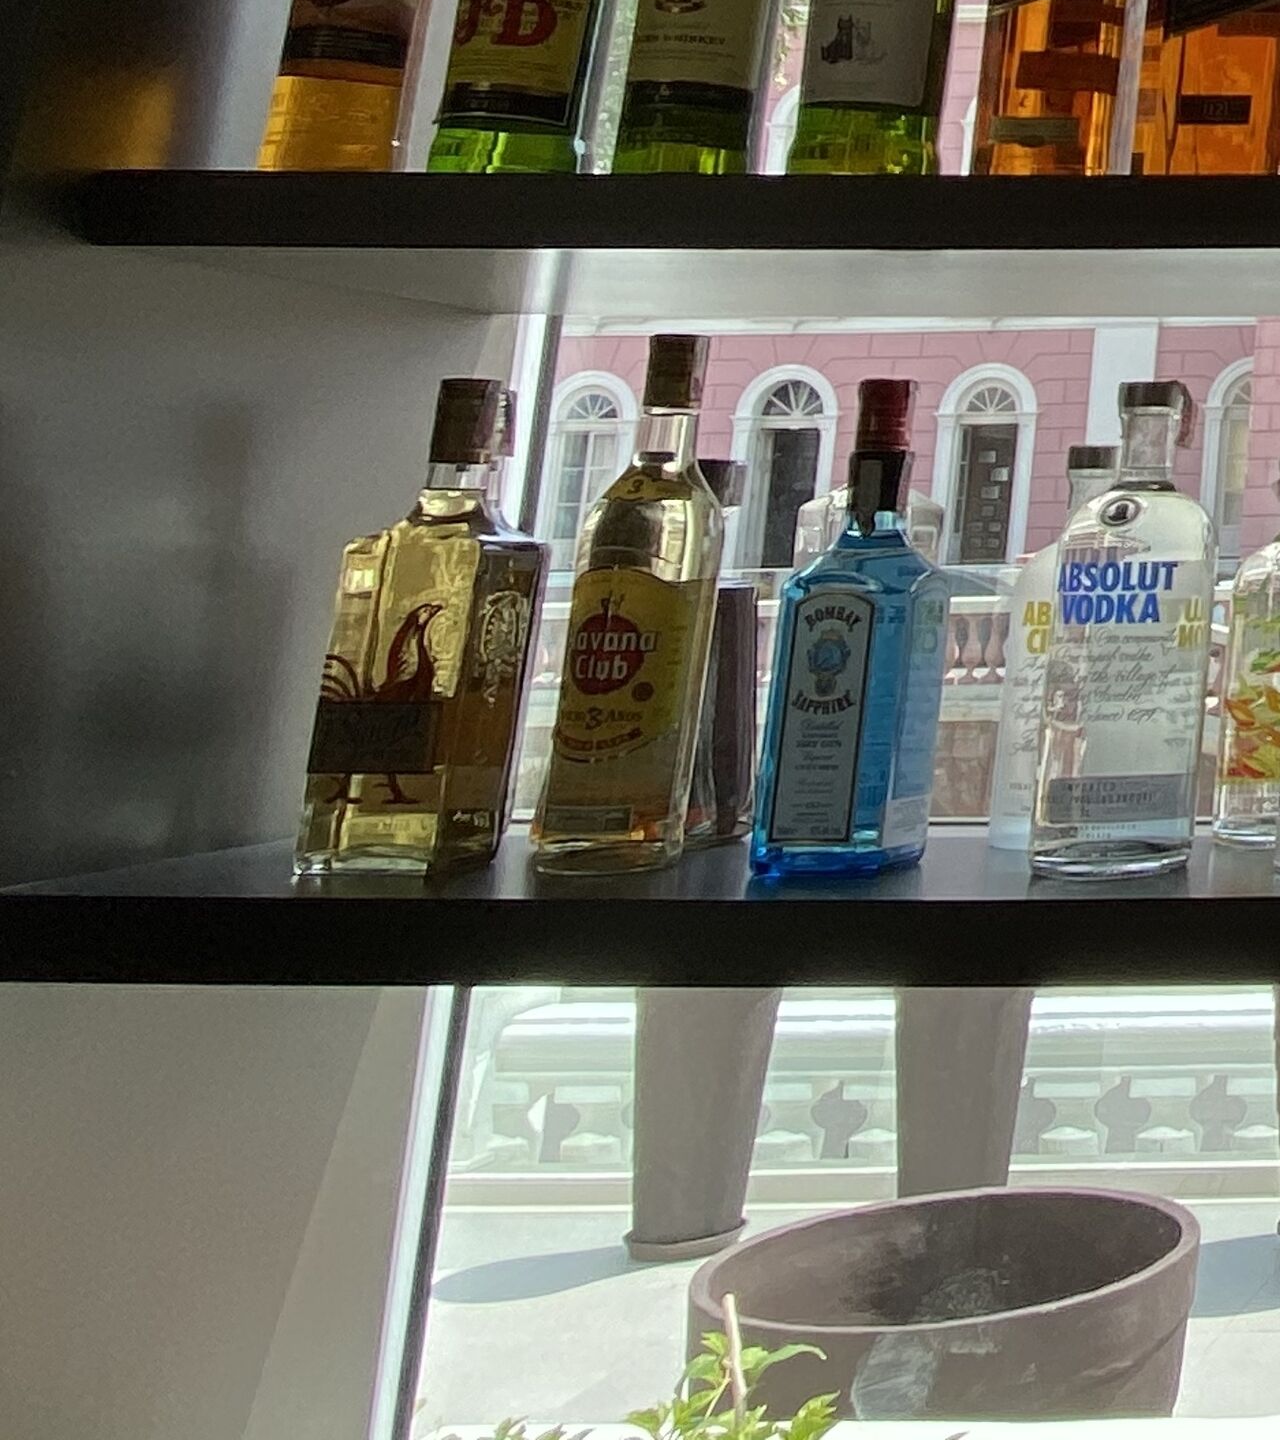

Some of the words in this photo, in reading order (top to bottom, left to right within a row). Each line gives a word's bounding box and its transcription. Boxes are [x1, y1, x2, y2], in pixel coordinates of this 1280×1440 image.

[1057, 560, 1179, 593] ABSOLUT
[803, 605, 862, 633] BOMBAY
[1061, 593, 1162, 625] VODKA
[575, 653, 629, 680] Club
